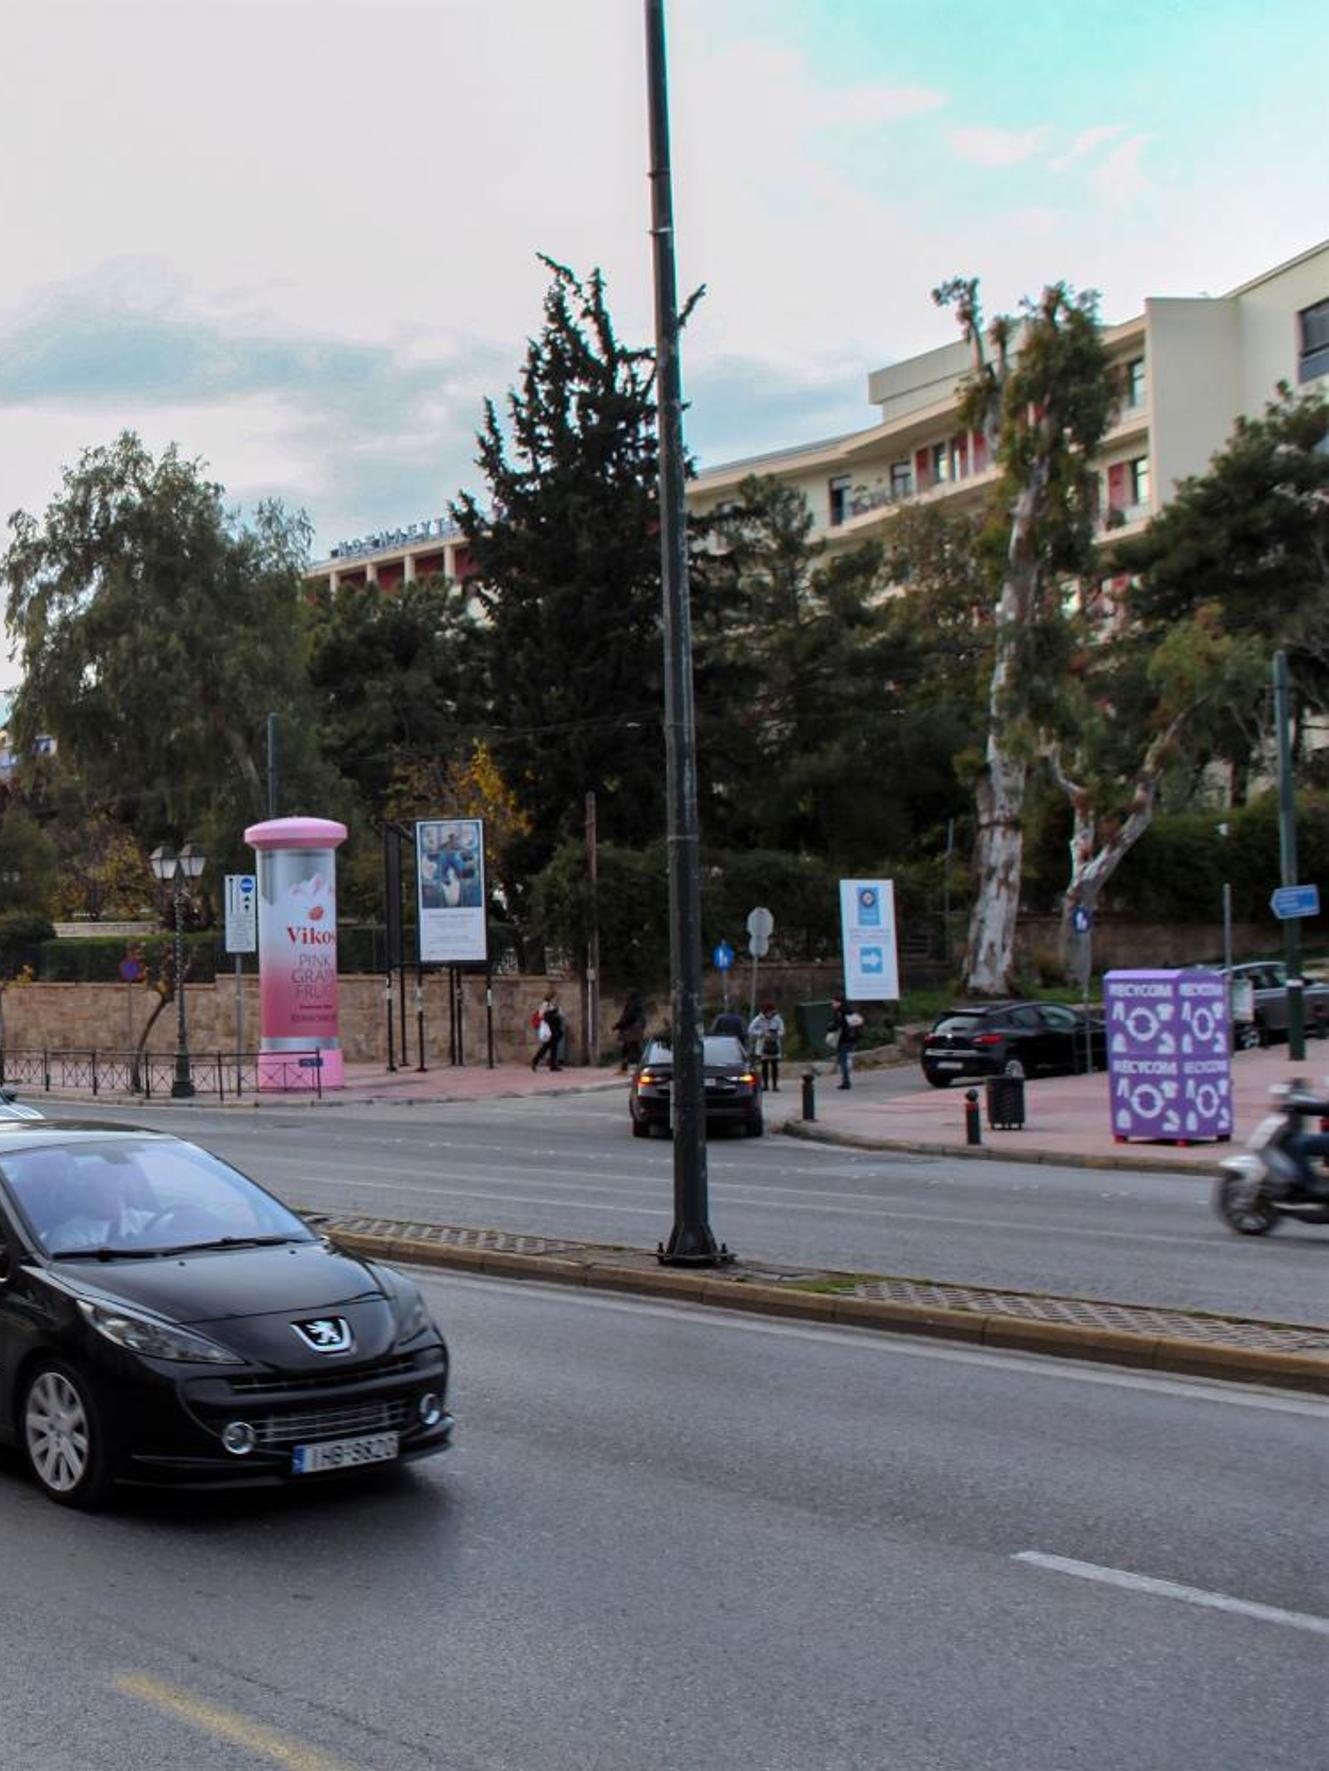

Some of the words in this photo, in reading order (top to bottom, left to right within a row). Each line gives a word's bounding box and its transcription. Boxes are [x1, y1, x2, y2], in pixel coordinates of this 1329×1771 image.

[299, 953, 331, 968] PINK
[1109, 983, 1172, 998] RECYCOM
[1112, 1060, 1178, 1075] RECYCOM
